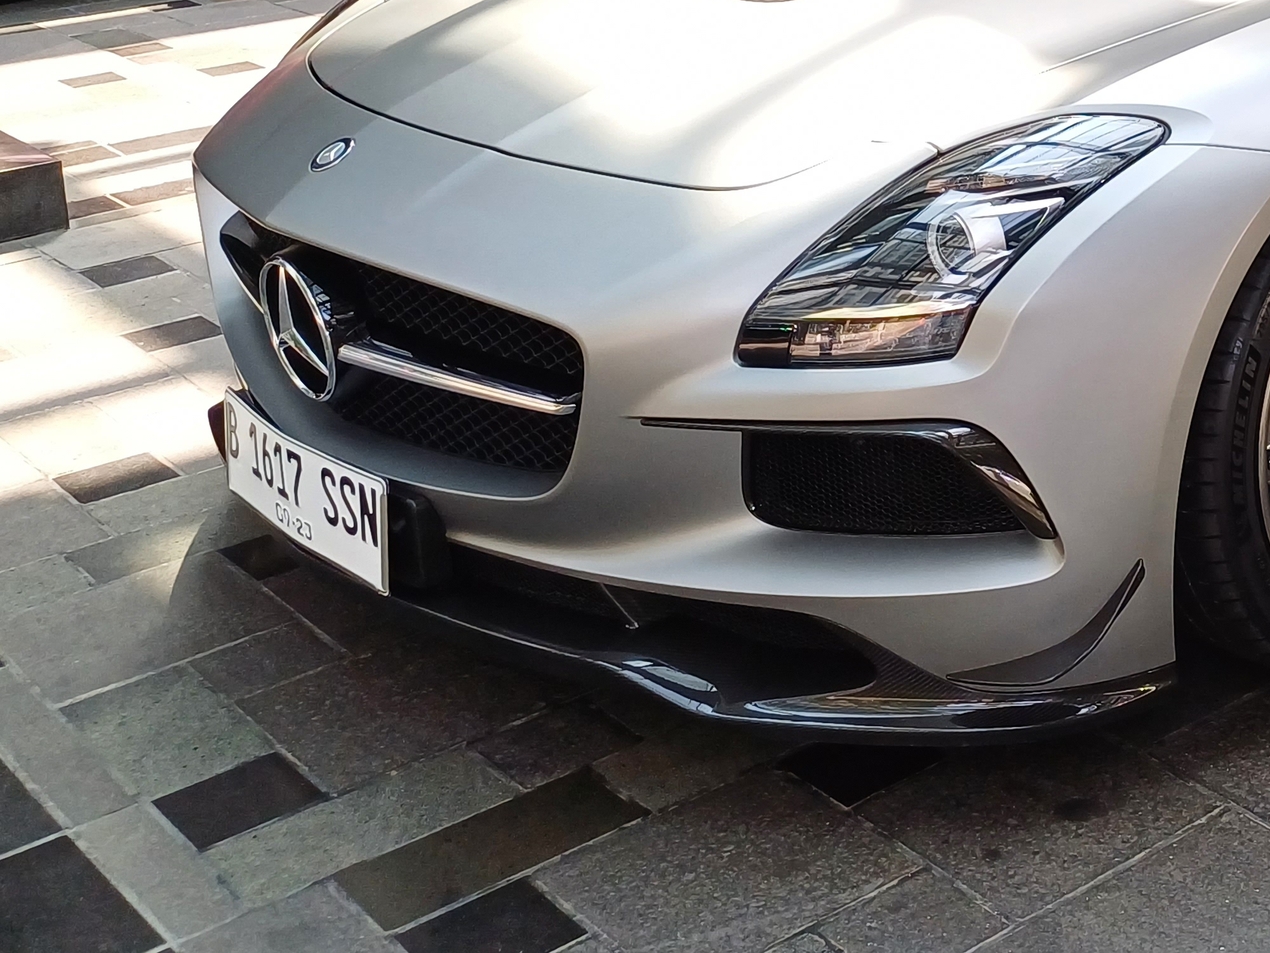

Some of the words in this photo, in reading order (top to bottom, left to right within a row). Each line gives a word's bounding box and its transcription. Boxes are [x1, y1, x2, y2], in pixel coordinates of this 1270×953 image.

[226, 402, 240, 459] B
[249, 421, 303, 508] 1617
[320, 467, 379, 548] SSN
[1232, 356, 1258, 505] MICHELIN
